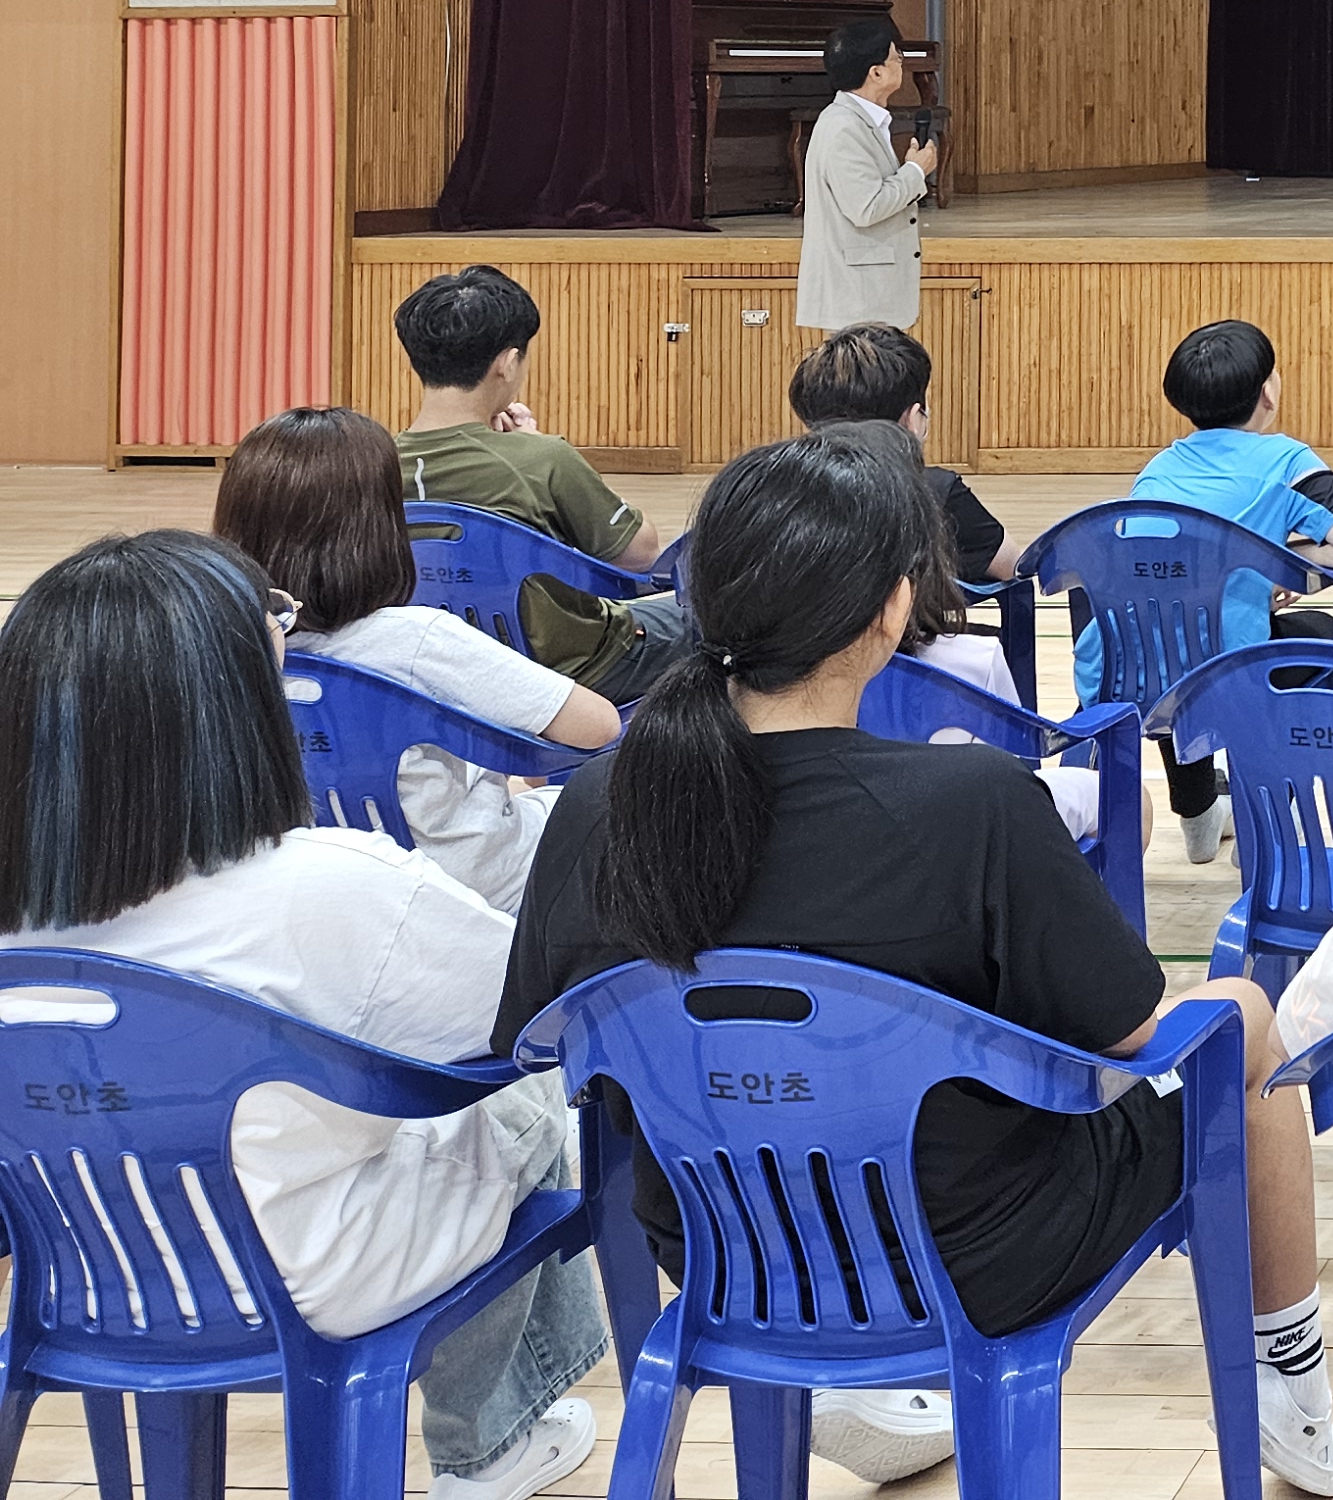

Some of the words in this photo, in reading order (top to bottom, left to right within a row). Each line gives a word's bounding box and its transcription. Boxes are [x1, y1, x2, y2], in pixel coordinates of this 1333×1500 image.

[420, 566, 474, 584] 도안초
[1134, 562, 1187, 579] 도안초
[24, 1080, 132, 1116] 도안초
[707, 1072, 815, 1104] 도안초
[1275, 1326, 1306, 1348] NIKE
